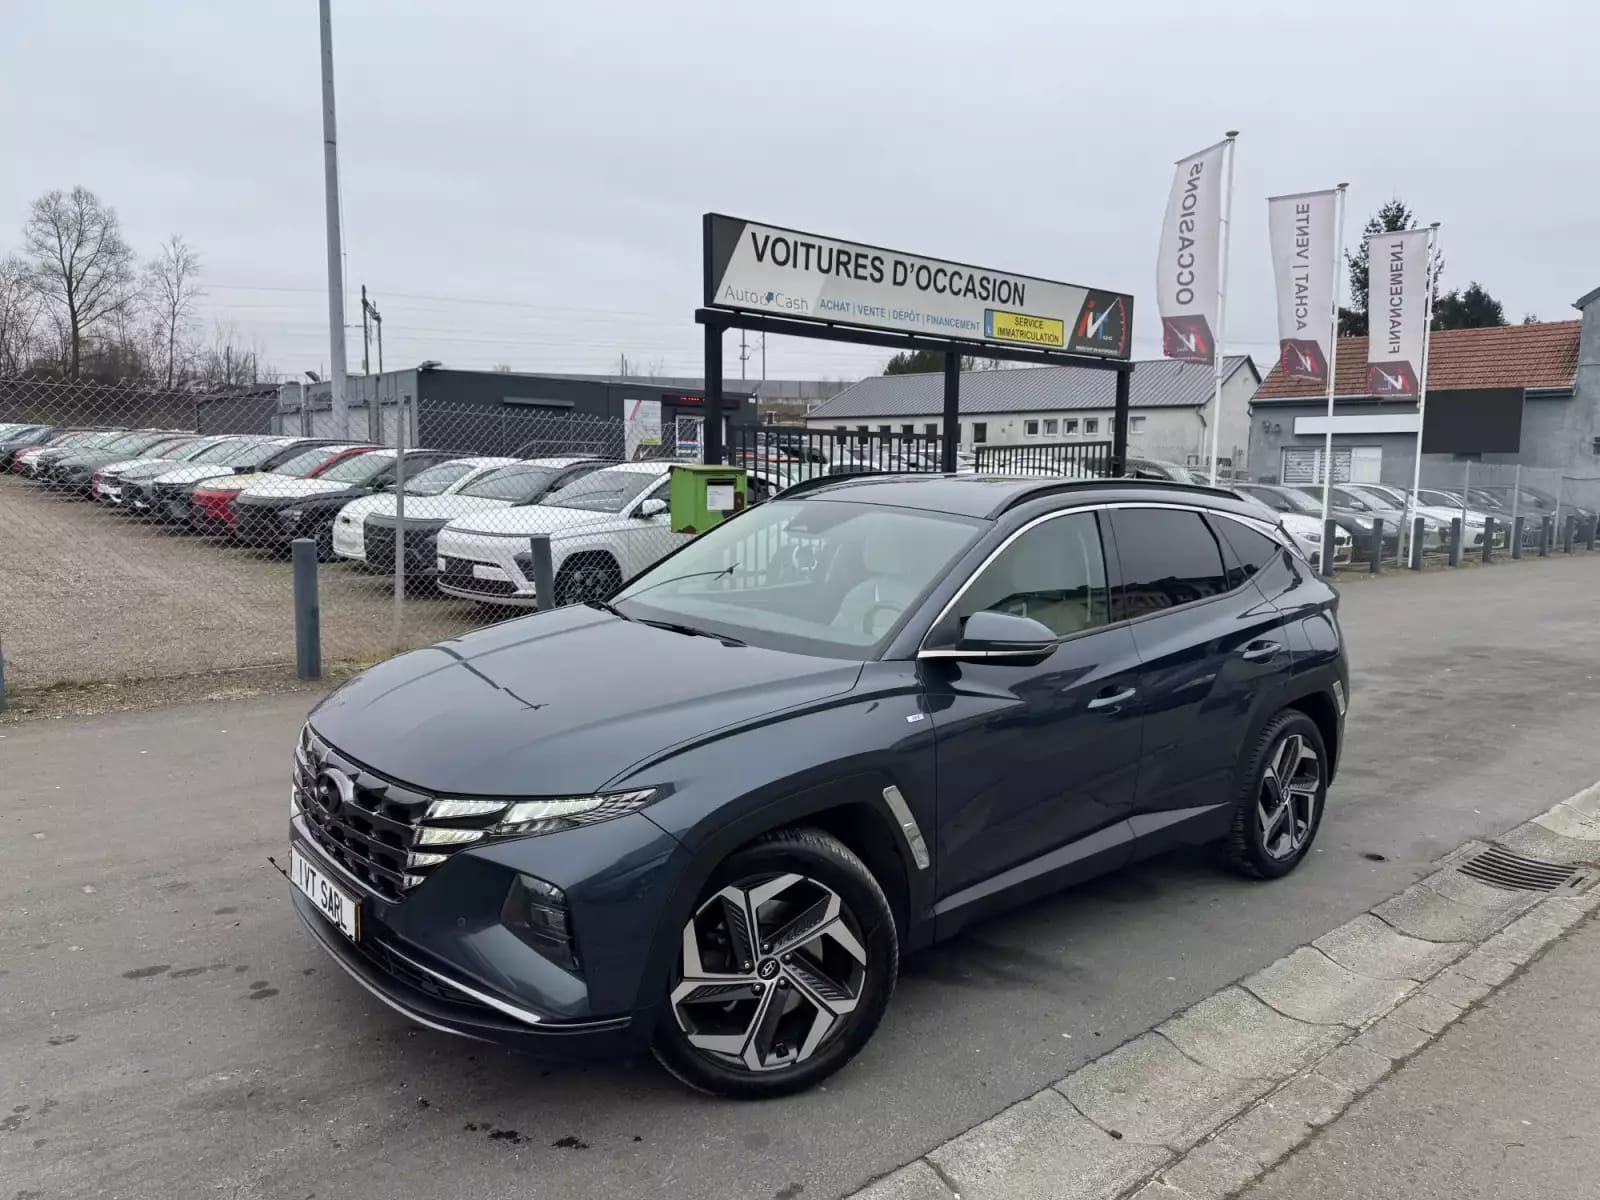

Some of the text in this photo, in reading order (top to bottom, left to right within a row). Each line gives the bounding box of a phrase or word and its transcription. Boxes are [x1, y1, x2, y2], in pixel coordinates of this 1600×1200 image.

[751, 231, 885, 283] VOITURES
[820, 299, 851, 312] ACHAT
[857, 304, 886, 318] VENTE
[926, 314, 981, 331] FINANCEMENT
[1014, 316, 1044, 330] SERVICE
[997, 327, 1059, 343] IMMATRICULATION
[299, 858, 348, 930] IVT SARL
